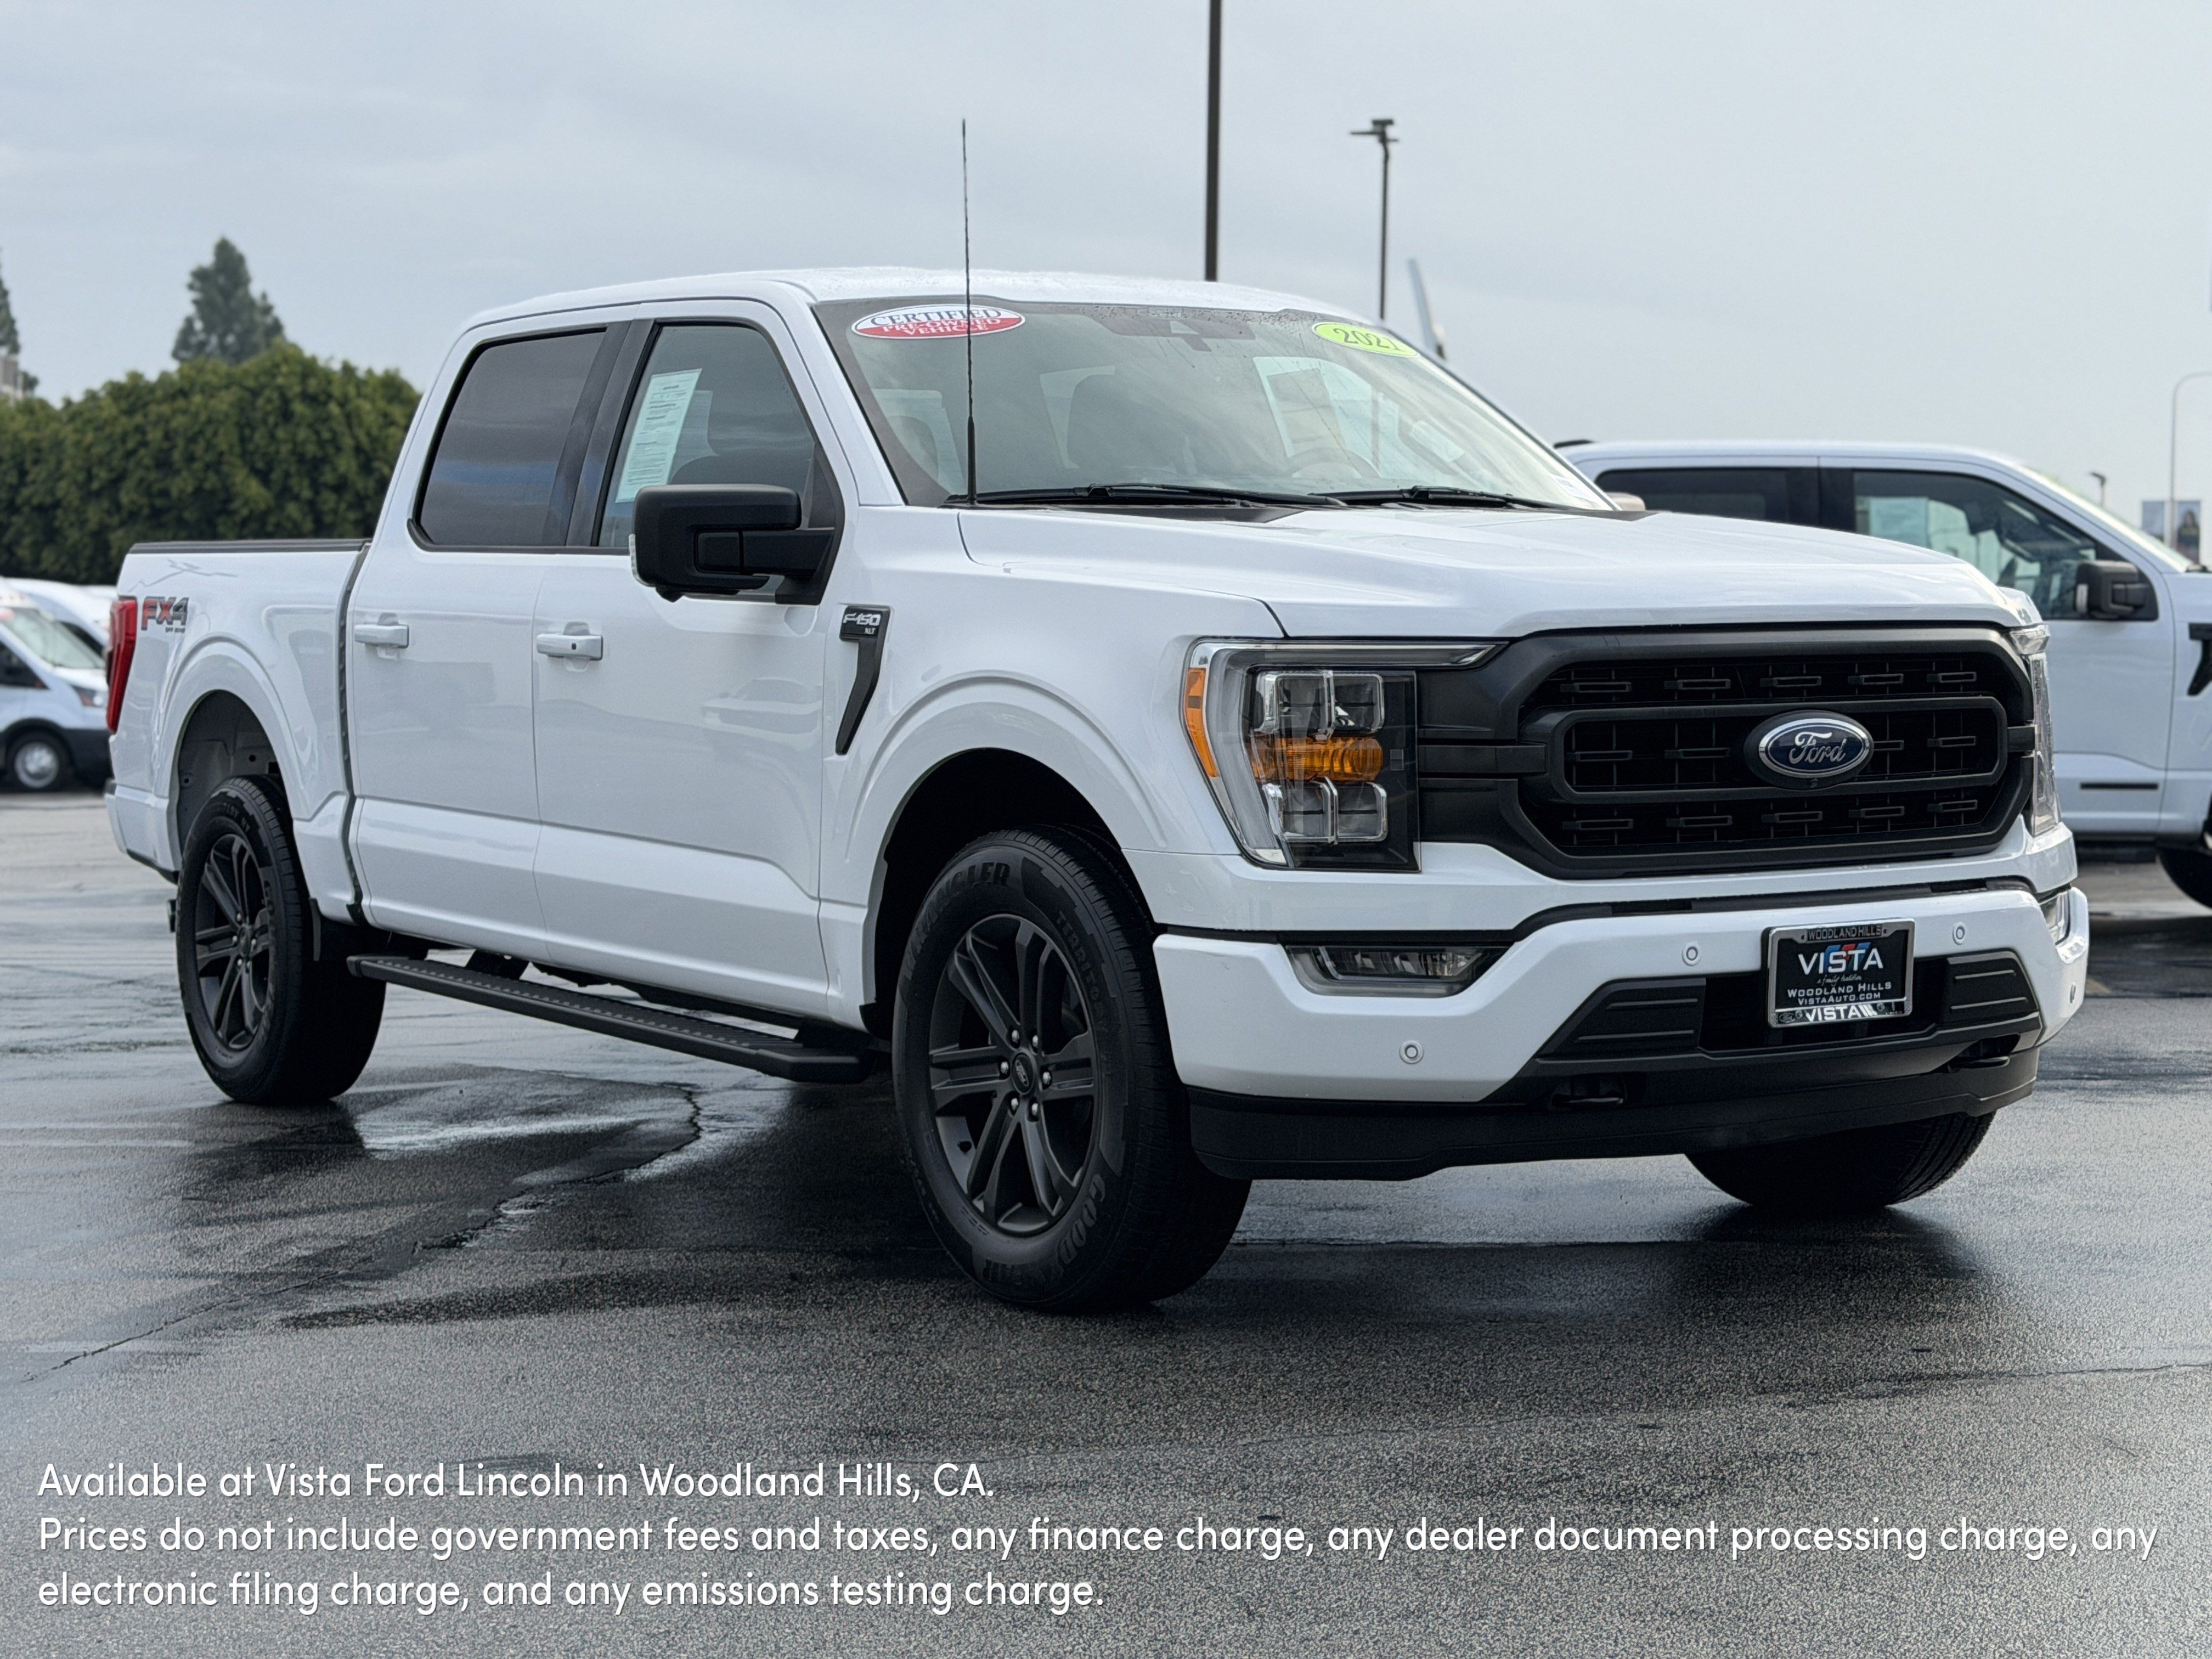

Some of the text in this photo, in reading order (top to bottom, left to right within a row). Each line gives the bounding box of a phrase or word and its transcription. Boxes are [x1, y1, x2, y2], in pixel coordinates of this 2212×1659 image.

[871, 309, 1001, 326] CERTIFIED
[882, 318, 1001, 332] PRE-OWNED
[902, 324, 989, 335] VEHICLE
[1333, 328, 1406, 352] 2021
[141, 596, 189, 631] FX4
[843, 612, 881, 626] F-150
[1788, 731, 1847, 764] Ford
[1808, 924, 1882, 940] WOODLAND HILLS
[1798, 948, 1883, 975] VISTA
[1787, 981, 1892, 998] WOODLAND HILLS
[1804, 1005, 1862, 1022] VISTA
